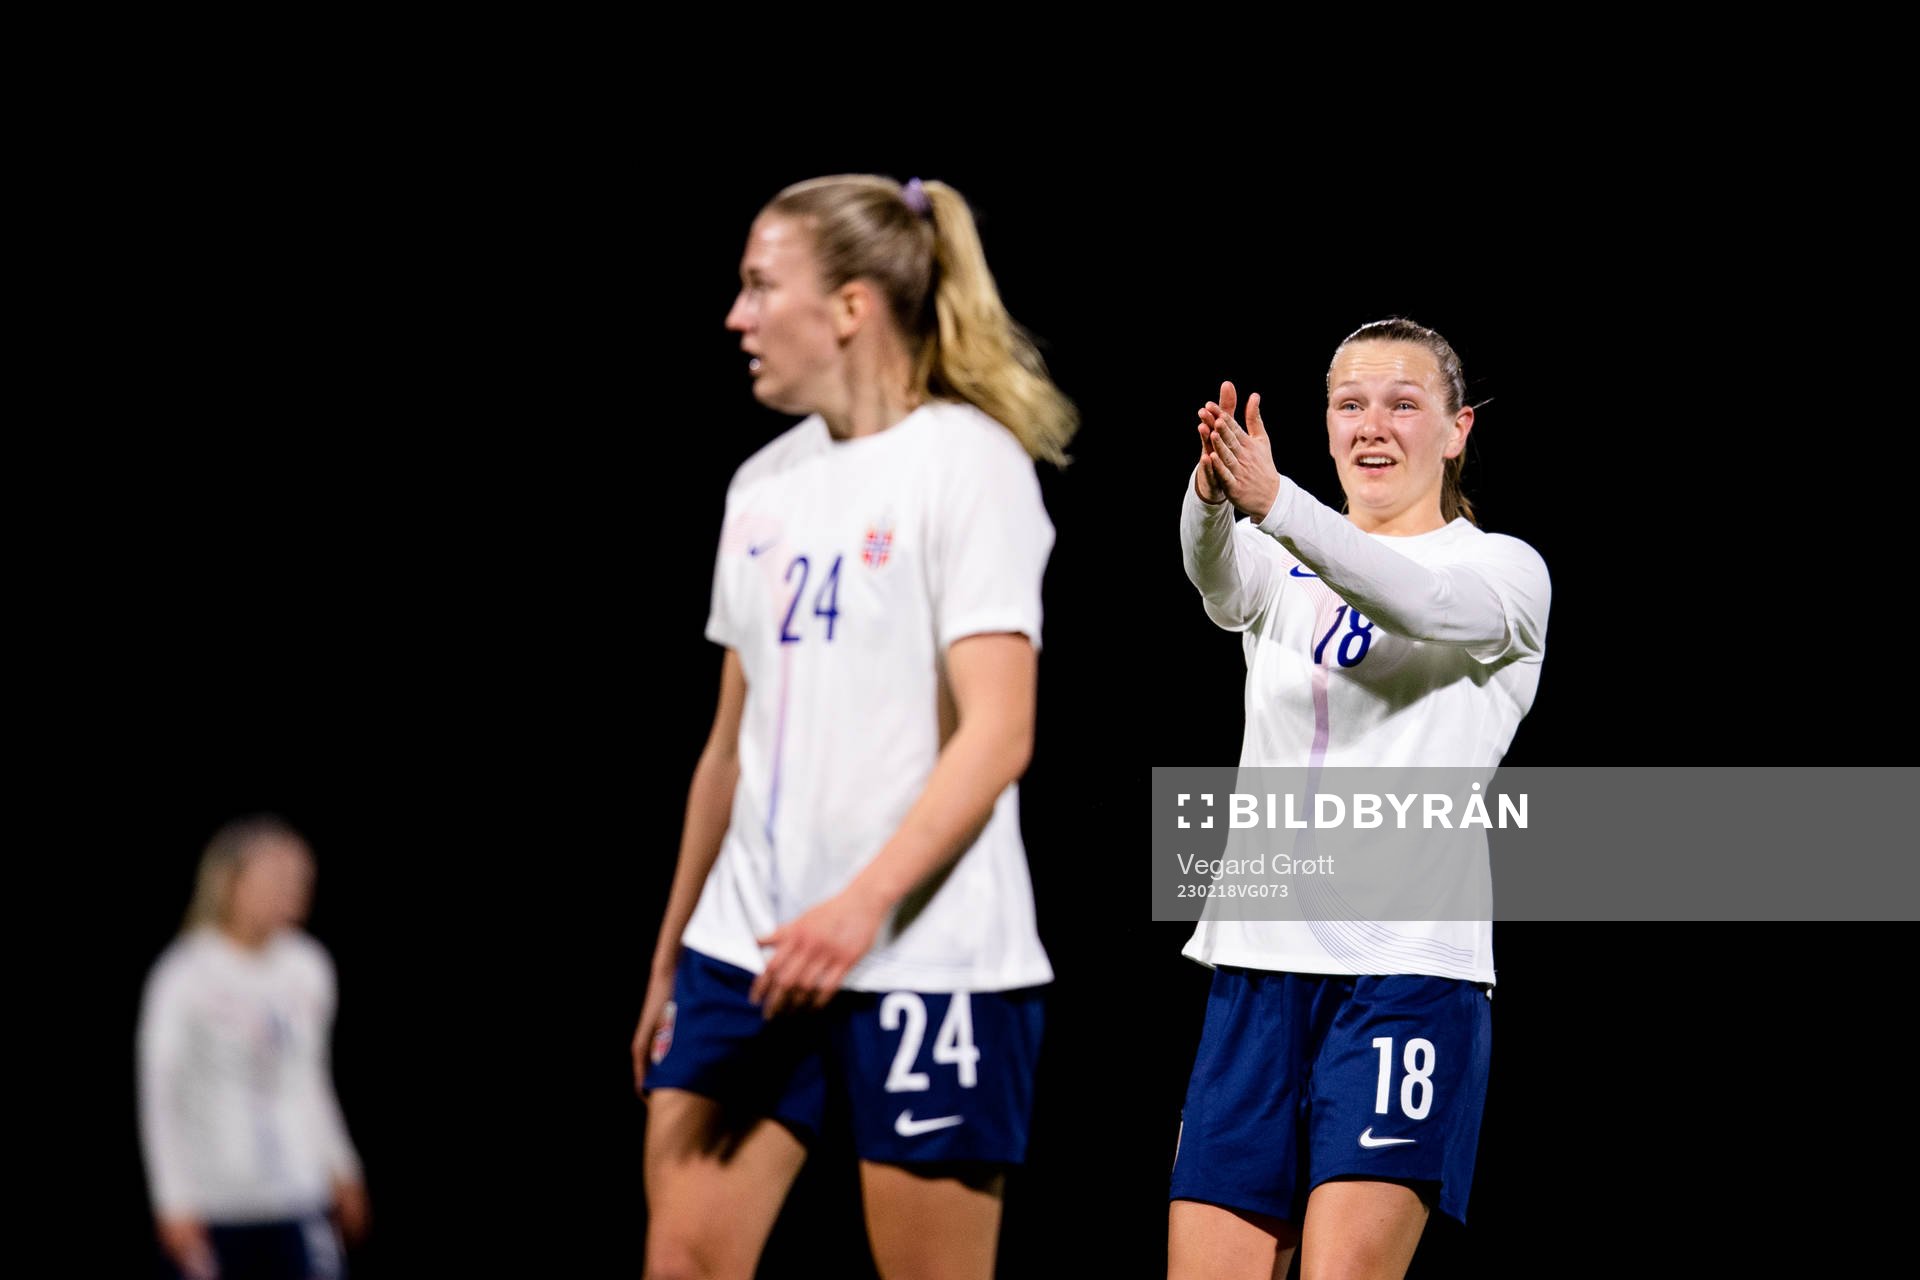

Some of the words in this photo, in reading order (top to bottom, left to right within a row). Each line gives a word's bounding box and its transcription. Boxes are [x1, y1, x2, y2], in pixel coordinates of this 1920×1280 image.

[779, 553, 842, 645] 24
[1314, 603, 1375, 668] 18
[879, 990, 981, 1093] 24
[1372, 1037, 1436, 1121] 18
